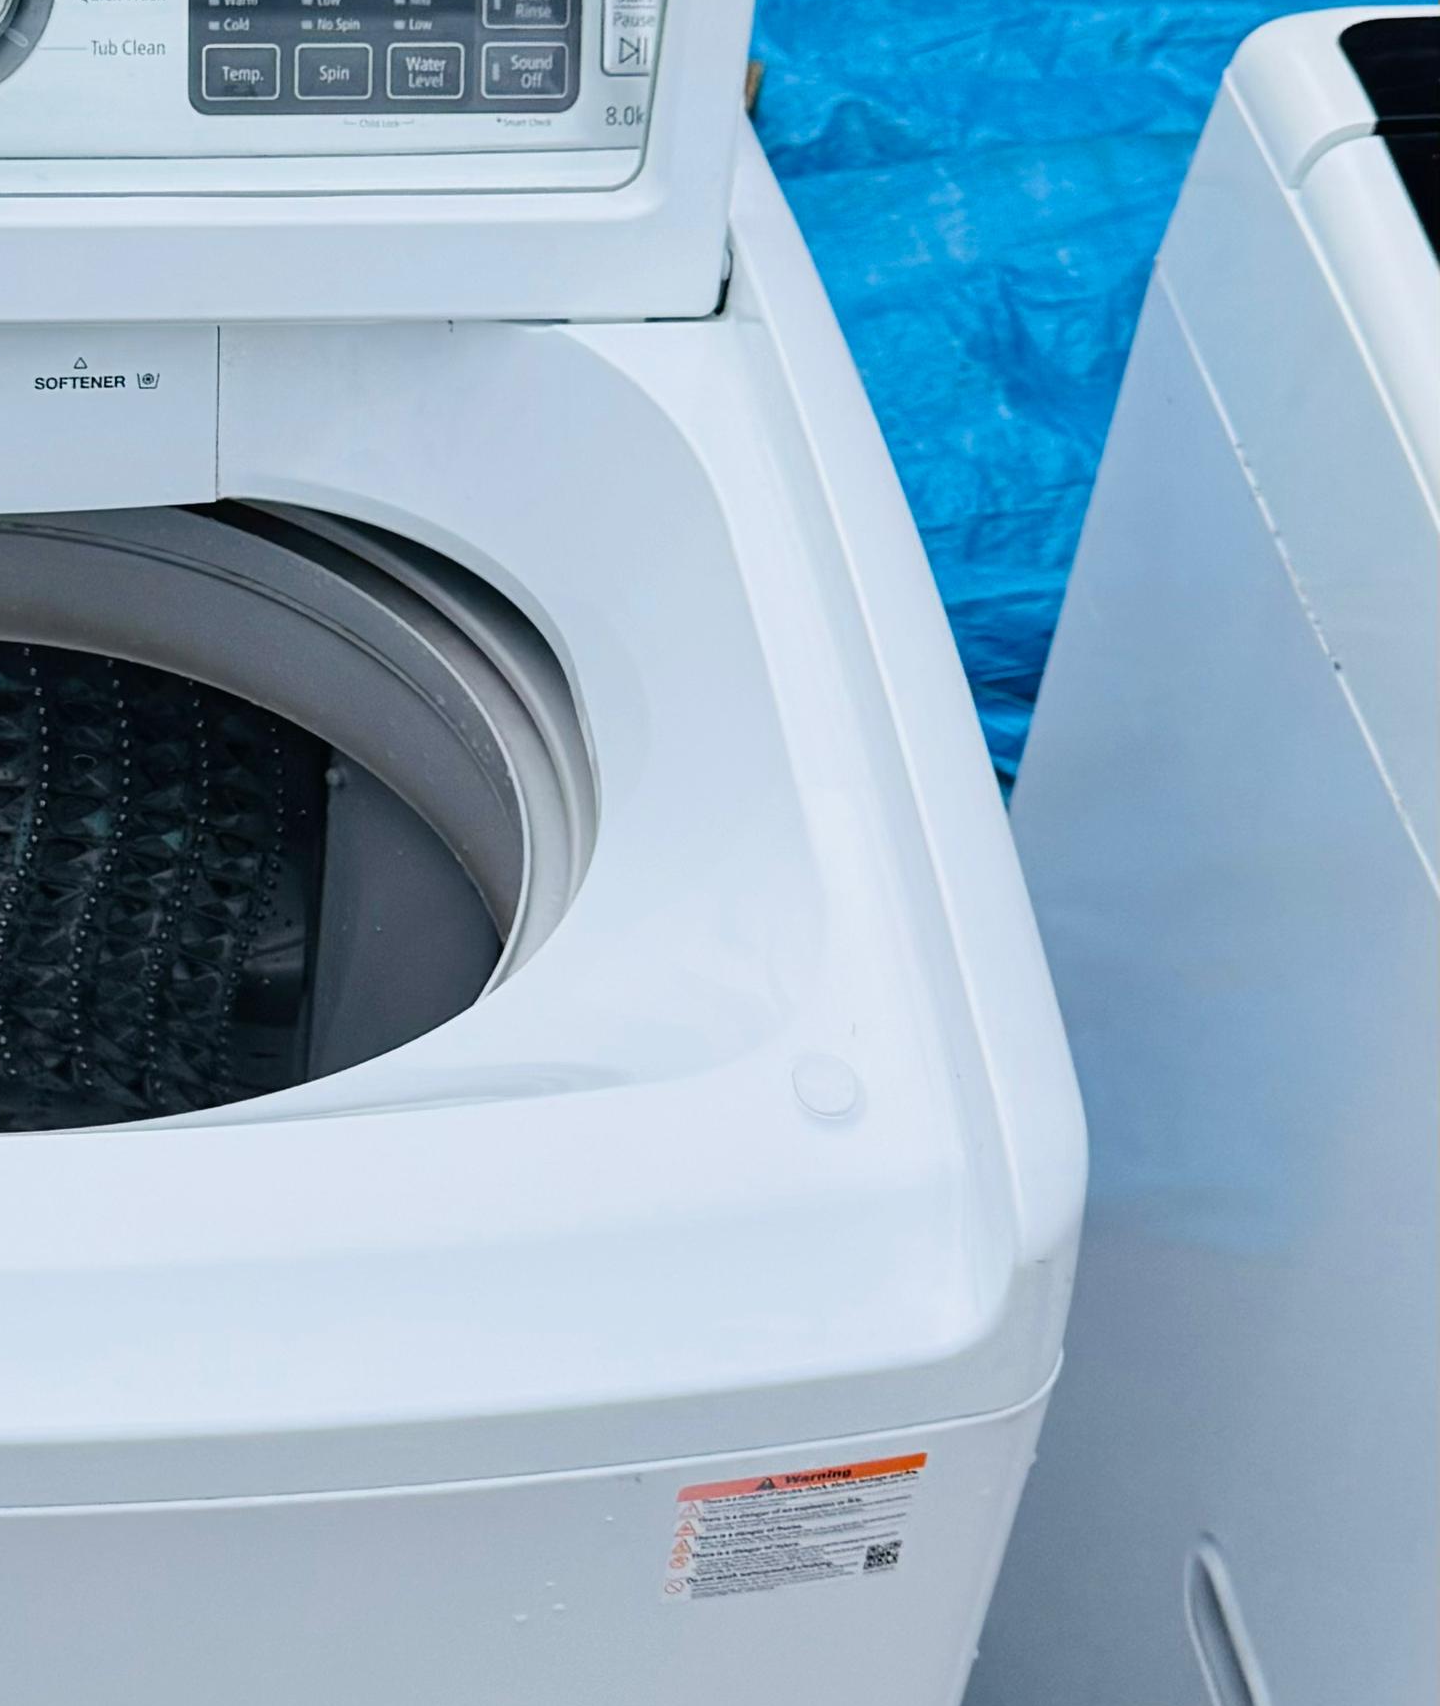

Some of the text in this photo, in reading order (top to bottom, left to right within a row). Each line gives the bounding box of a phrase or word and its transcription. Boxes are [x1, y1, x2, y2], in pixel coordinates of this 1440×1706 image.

[515, 4, 552, 19] Rinse
[612, 11, 656, 27] Pause
[223, 17, 250, 31] Cold
[317, 17, 360, 33] No Spin
[410, 18, 433, 31] Low
[91, 40, 166, 56] Tub Clean
[406, 56, 448, 72] Water
[511, 54, 553, 70] Sound
[222, 66, 264, 84] Temp.
[319, 65, 350, 83] Spin
[408, 73, 444, 88] Level
[520, 72, 543, 89] Off
[34, 376, 126, 390] SOFTENER
[783, 1467, 852, 1484] Warning
